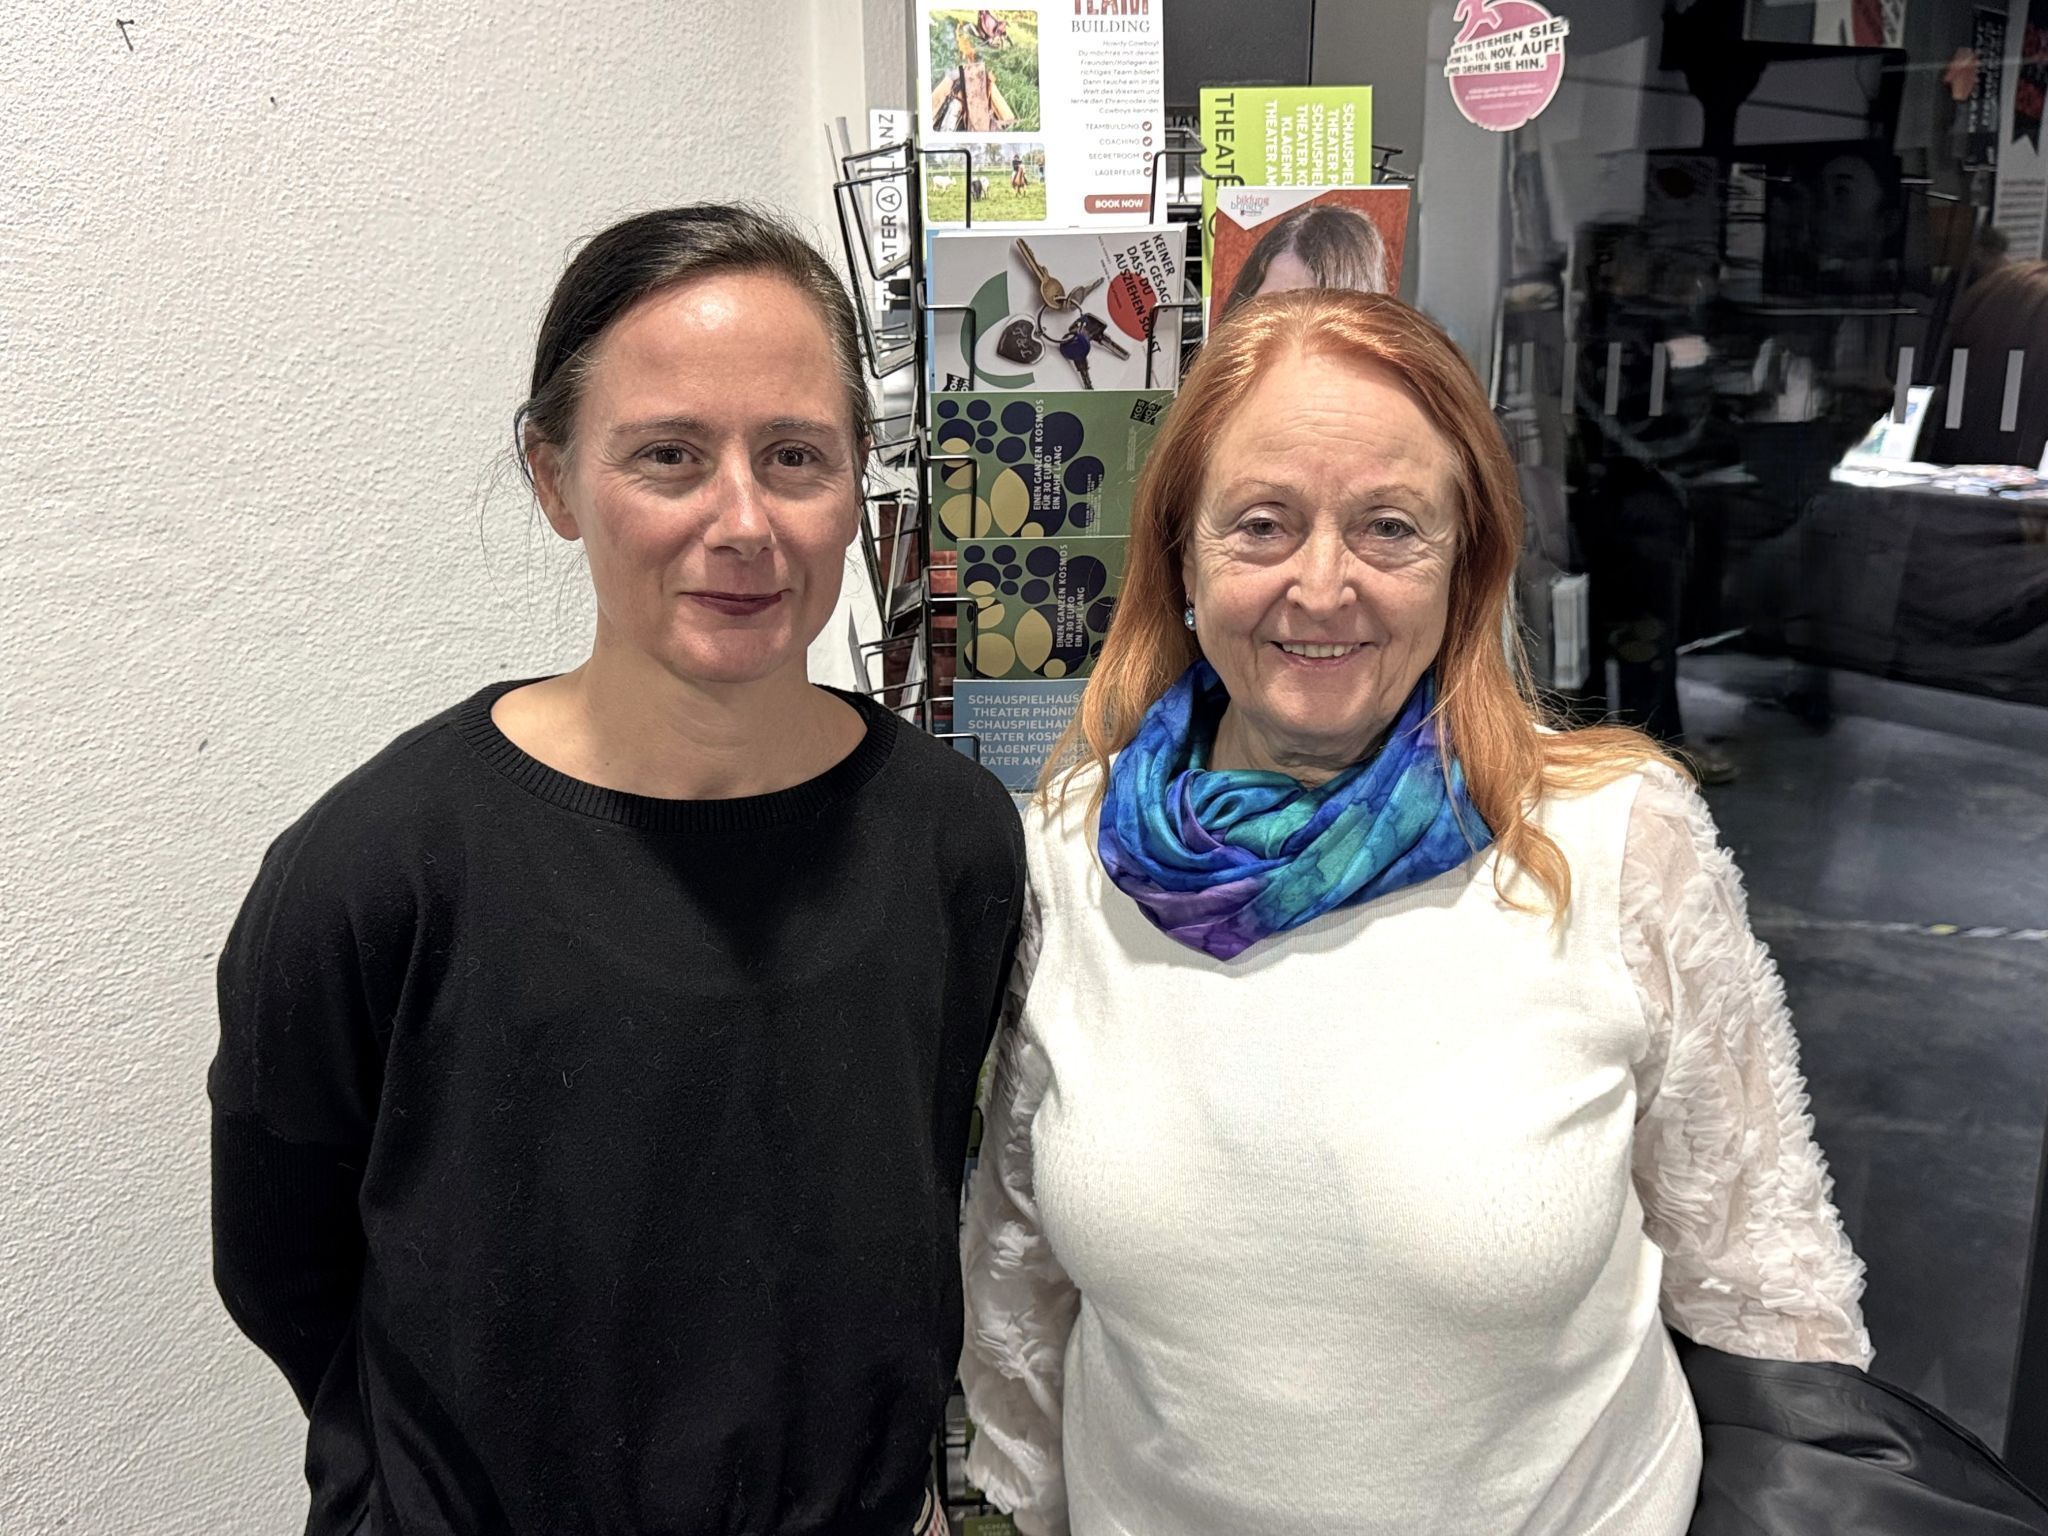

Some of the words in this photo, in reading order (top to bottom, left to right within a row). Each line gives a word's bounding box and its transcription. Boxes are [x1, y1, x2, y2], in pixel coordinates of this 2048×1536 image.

[1071, 20, 1150, 32] BUILDING
[1475, 31, 1523, 50] STEHEN
[1529, 21, 1564, 38] SIE
[1490, 46, 1516, 59] NOV.
[1521, 37, 1560, 56] AUF!
[1494, 61, 1511, 72] SIE
[1516, 58, 1545, 70] HIN.
[1265, 100, 1278, 162] THEATER
[1296, 104, 1309, 167] THEATER
[1327, 108, 1339, 173] THEATER
[1095, 199, 1120, 208] BOOK
[1121, 199, 1144, 208] NOW
[1152, 233, 1175, 276] KEINER
[1127, 245, 1146, 277] DASS
[1140, 277, 1154, 296] DU
[1140, 239, 1156, 263] HAT
[1150, 265, 1172, 313] GESAG,
[1113, 253, 1146, 316] AUSZIEHEN
[1139, 316, 1161, 353] SOST
[1035, 399, 1044, 442] KOSMOS
[1034, 445, 1043, 484] GANZEN
[1043, 455, 1052, 480] EURO
[1053, 445, 1062, 470] LANG
[1043, 481, 1051, 492] 30
[1053, 474, 1061, 497] JAHR
[1033, 486, 1042, 510] EINEN
[1042, 495, 1051, 510] FÜR
[1052, 498, 1060, 510] EIN
[1059, 544, 1068, 584] KOSMOS
[1057, 587, 1066, 623] GANZEN
[1066, 596, 1076, 620] EURO
[1077, 586, 1086, 610] LANG
[1066, 621, 1075, 631] 30
[1075, 613, 1084, 633] JAHR
[1056, 625, 1065, 648] EINEN
[1064, 632, 1074, 648] FÜR
[1075, 635, 1083, 647] EIN
[968, 694, 1080, 705] SCHAUSPIELHAUS
[972, 707, 1029, 717] THEATER
[968, 720, 1070, 730] SCHAUSPIELHAU
[978, 732, 1024, 742] HEATER
[981, 757, 1019, 766] EATER
[1024, 757, 1041, 766] AM
